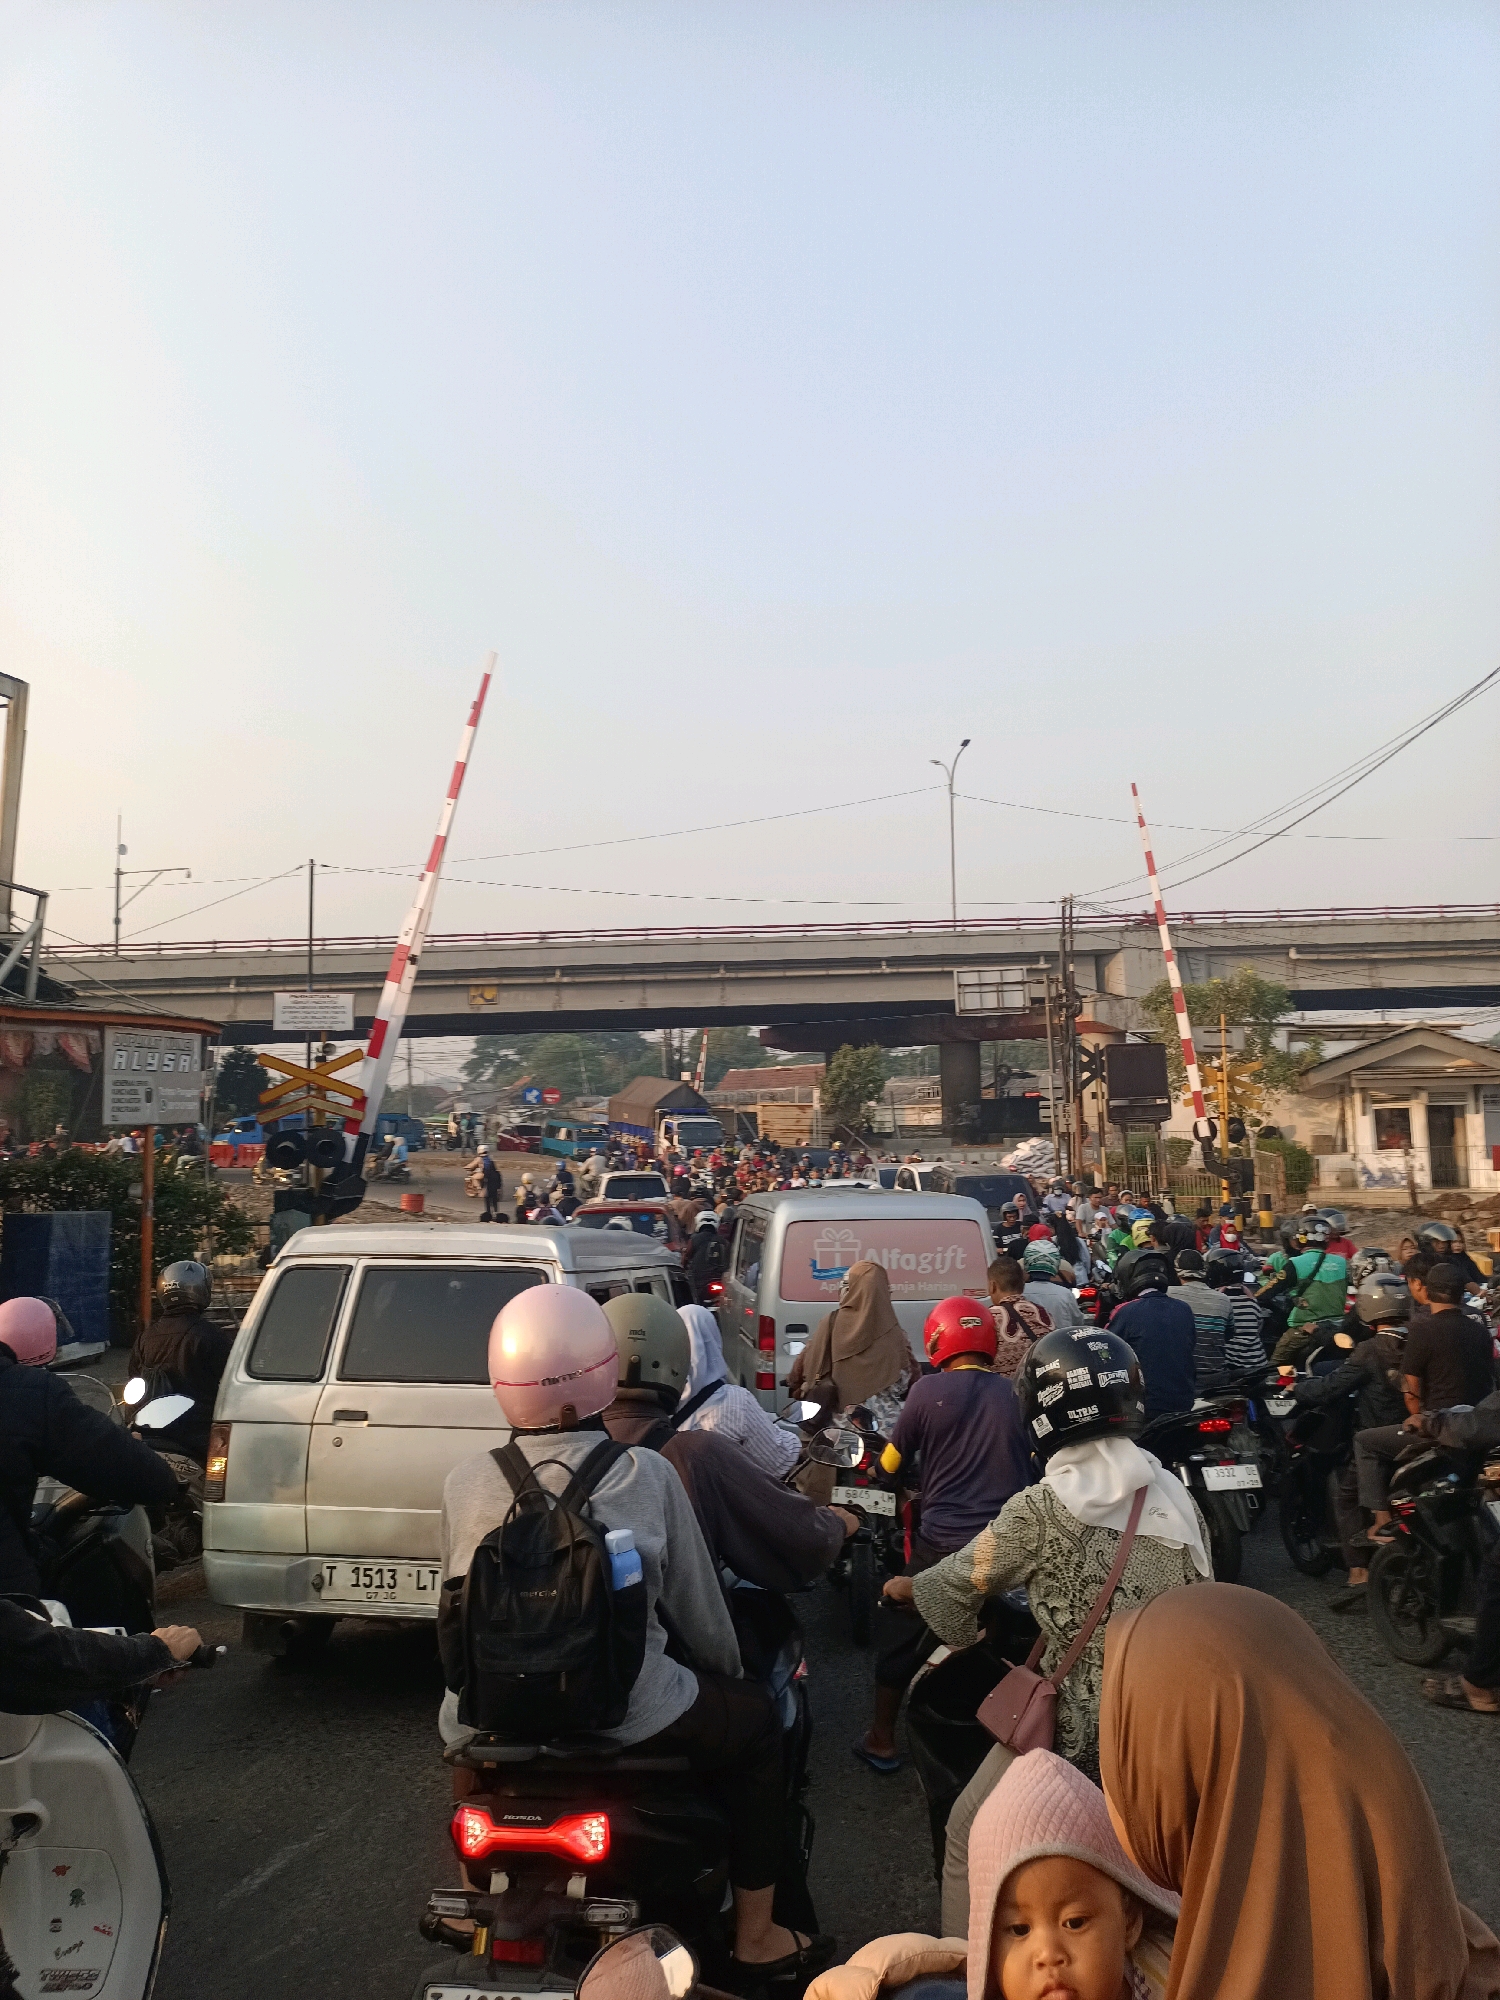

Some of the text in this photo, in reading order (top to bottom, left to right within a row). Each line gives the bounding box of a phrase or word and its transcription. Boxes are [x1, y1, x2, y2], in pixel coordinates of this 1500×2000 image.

[1067, 1404, 1099, 1419] ULTRAS
[325, 1565, 439, 1591] T 1513 LT
